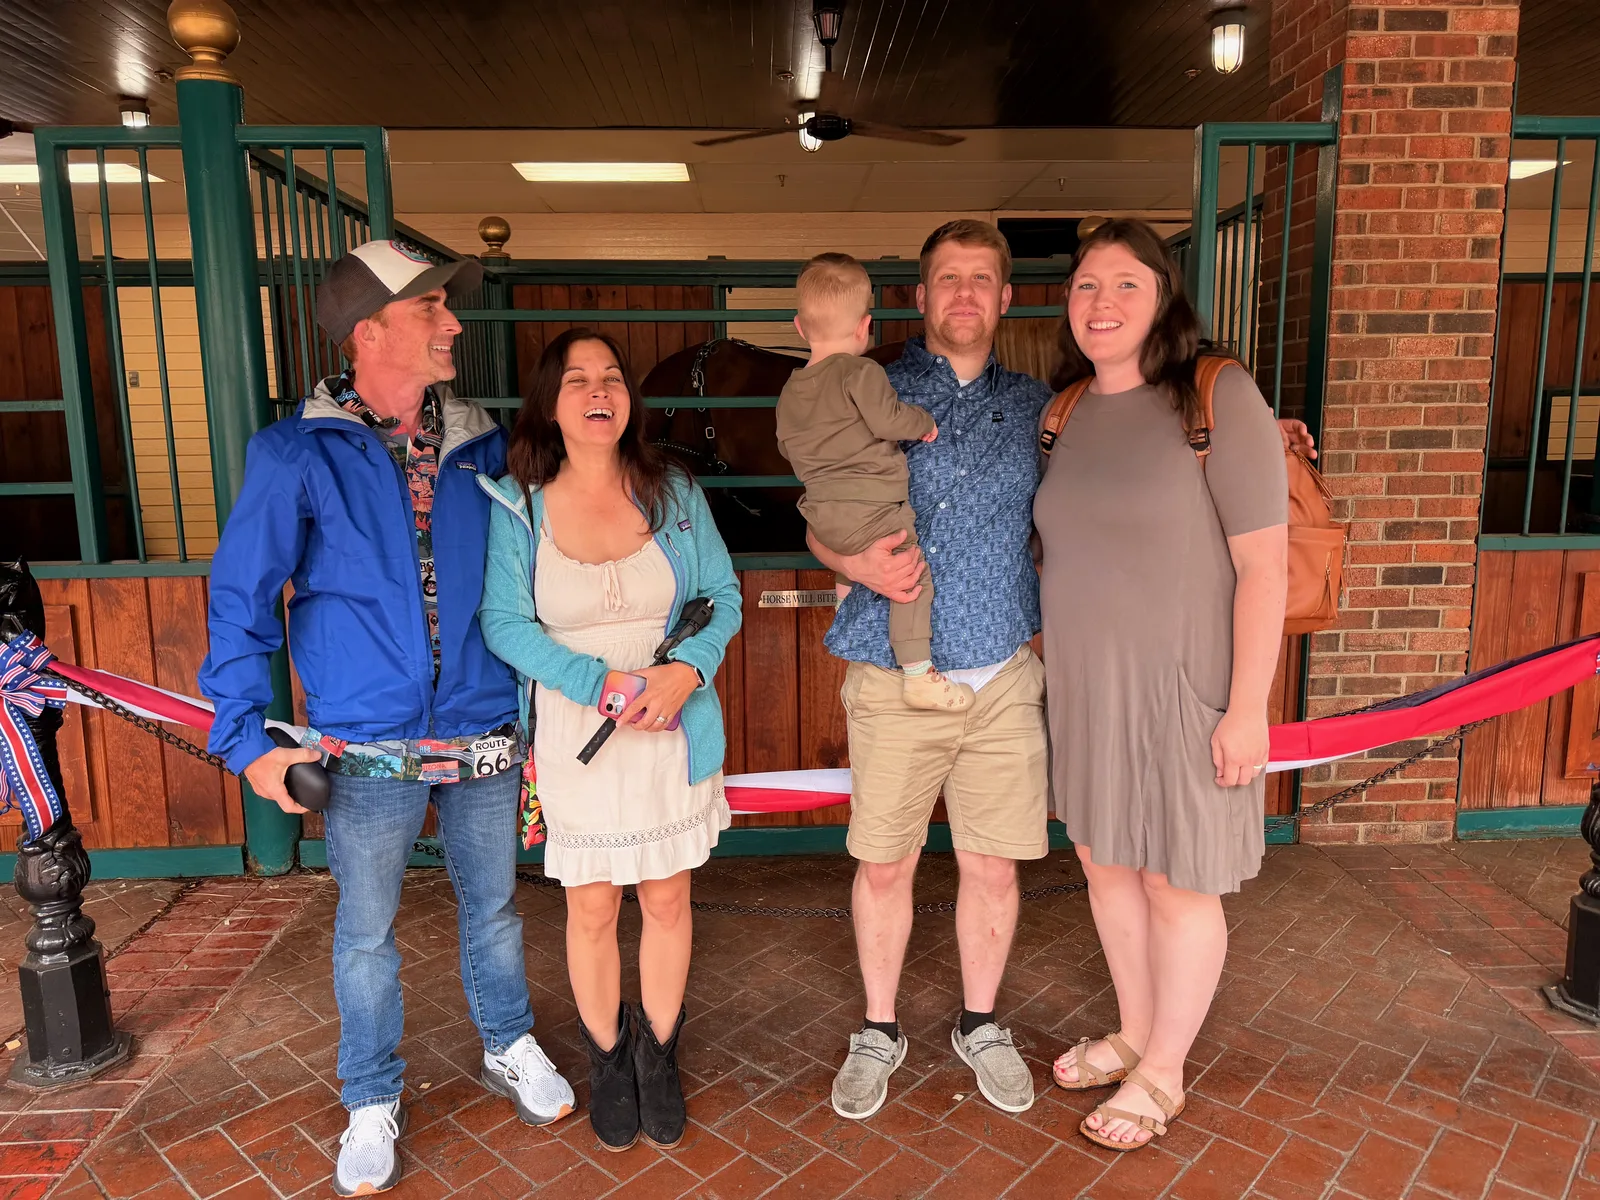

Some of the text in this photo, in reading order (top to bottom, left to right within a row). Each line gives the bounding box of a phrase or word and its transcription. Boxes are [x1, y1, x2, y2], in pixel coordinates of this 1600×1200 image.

[762, 593, 837, 604] HORSE WILL BITE
[475, 738, 508, 751] ROUTE
[476, 752, 508, 776] 66
